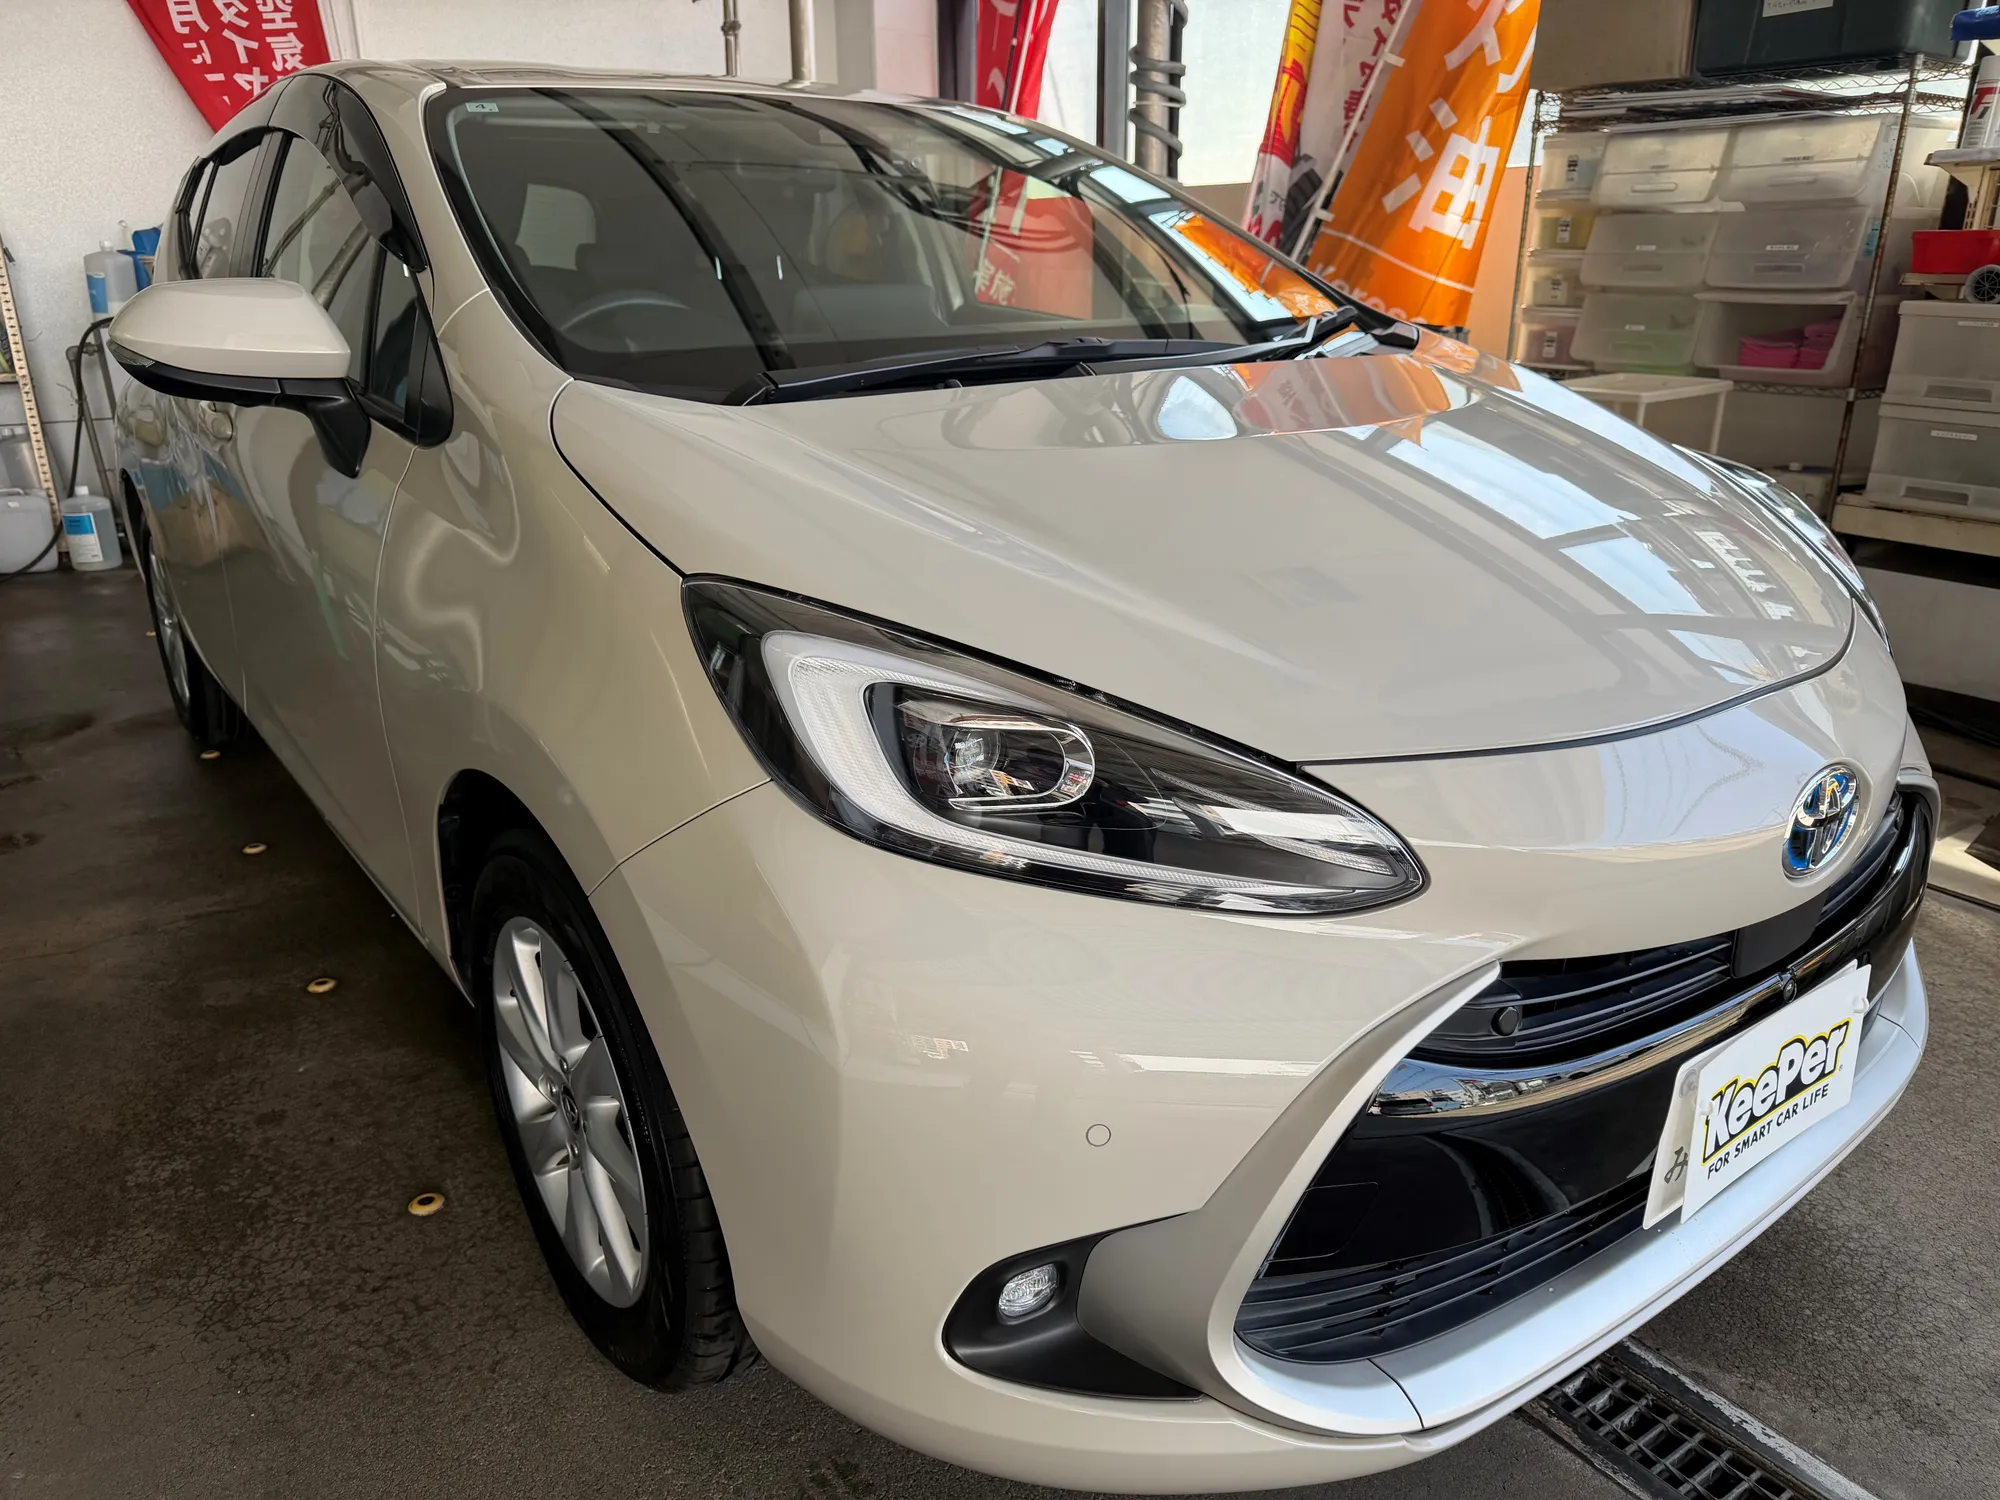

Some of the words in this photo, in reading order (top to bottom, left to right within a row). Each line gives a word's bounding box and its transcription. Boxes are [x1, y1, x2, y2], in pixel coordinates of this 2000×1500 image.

[1703, 1021, 1849, 1163] KeePer
[1707, 1156, 1730, 1180] FOR
[1733, 1120, 1772, 1159] SMART
[1776, 1104, 1799, 1127] CAR
[1802, 1083, 1829, 1111] LIFE
[1664, 1146, 1689, 1184] み
